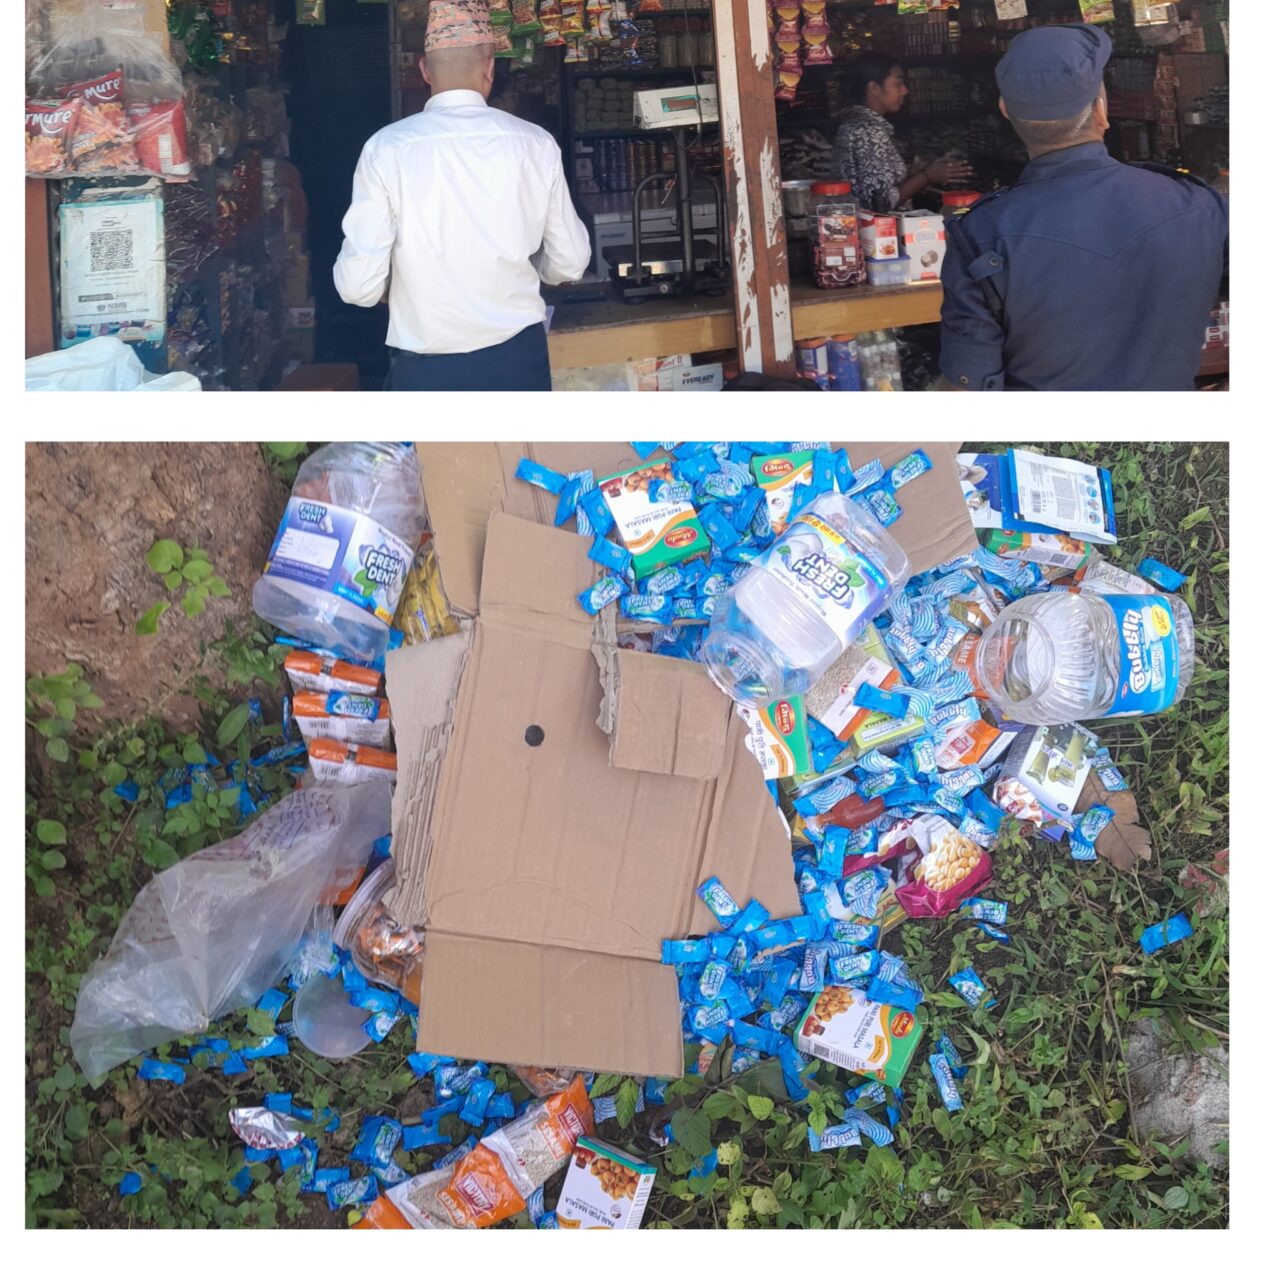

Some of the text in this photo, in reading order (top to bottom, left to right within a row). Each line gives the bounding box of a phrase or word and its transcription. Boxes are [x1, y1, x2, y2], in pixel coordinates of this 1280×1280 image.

[682, 373, 715, 385] EVEREADY
[299, 503, 327, 516] FRESH
[300, 510, 323, 523] DENT
[367, 550, 403, 574] FRESH
[810, 553, 852, 585] DENT
[368, 568, 397, 588] DENT
[792, 557, 851, 600] FRESH
[1124, 609, 1148, 693] Bubbly
[565, 1196, 589, 1215] MASALA
